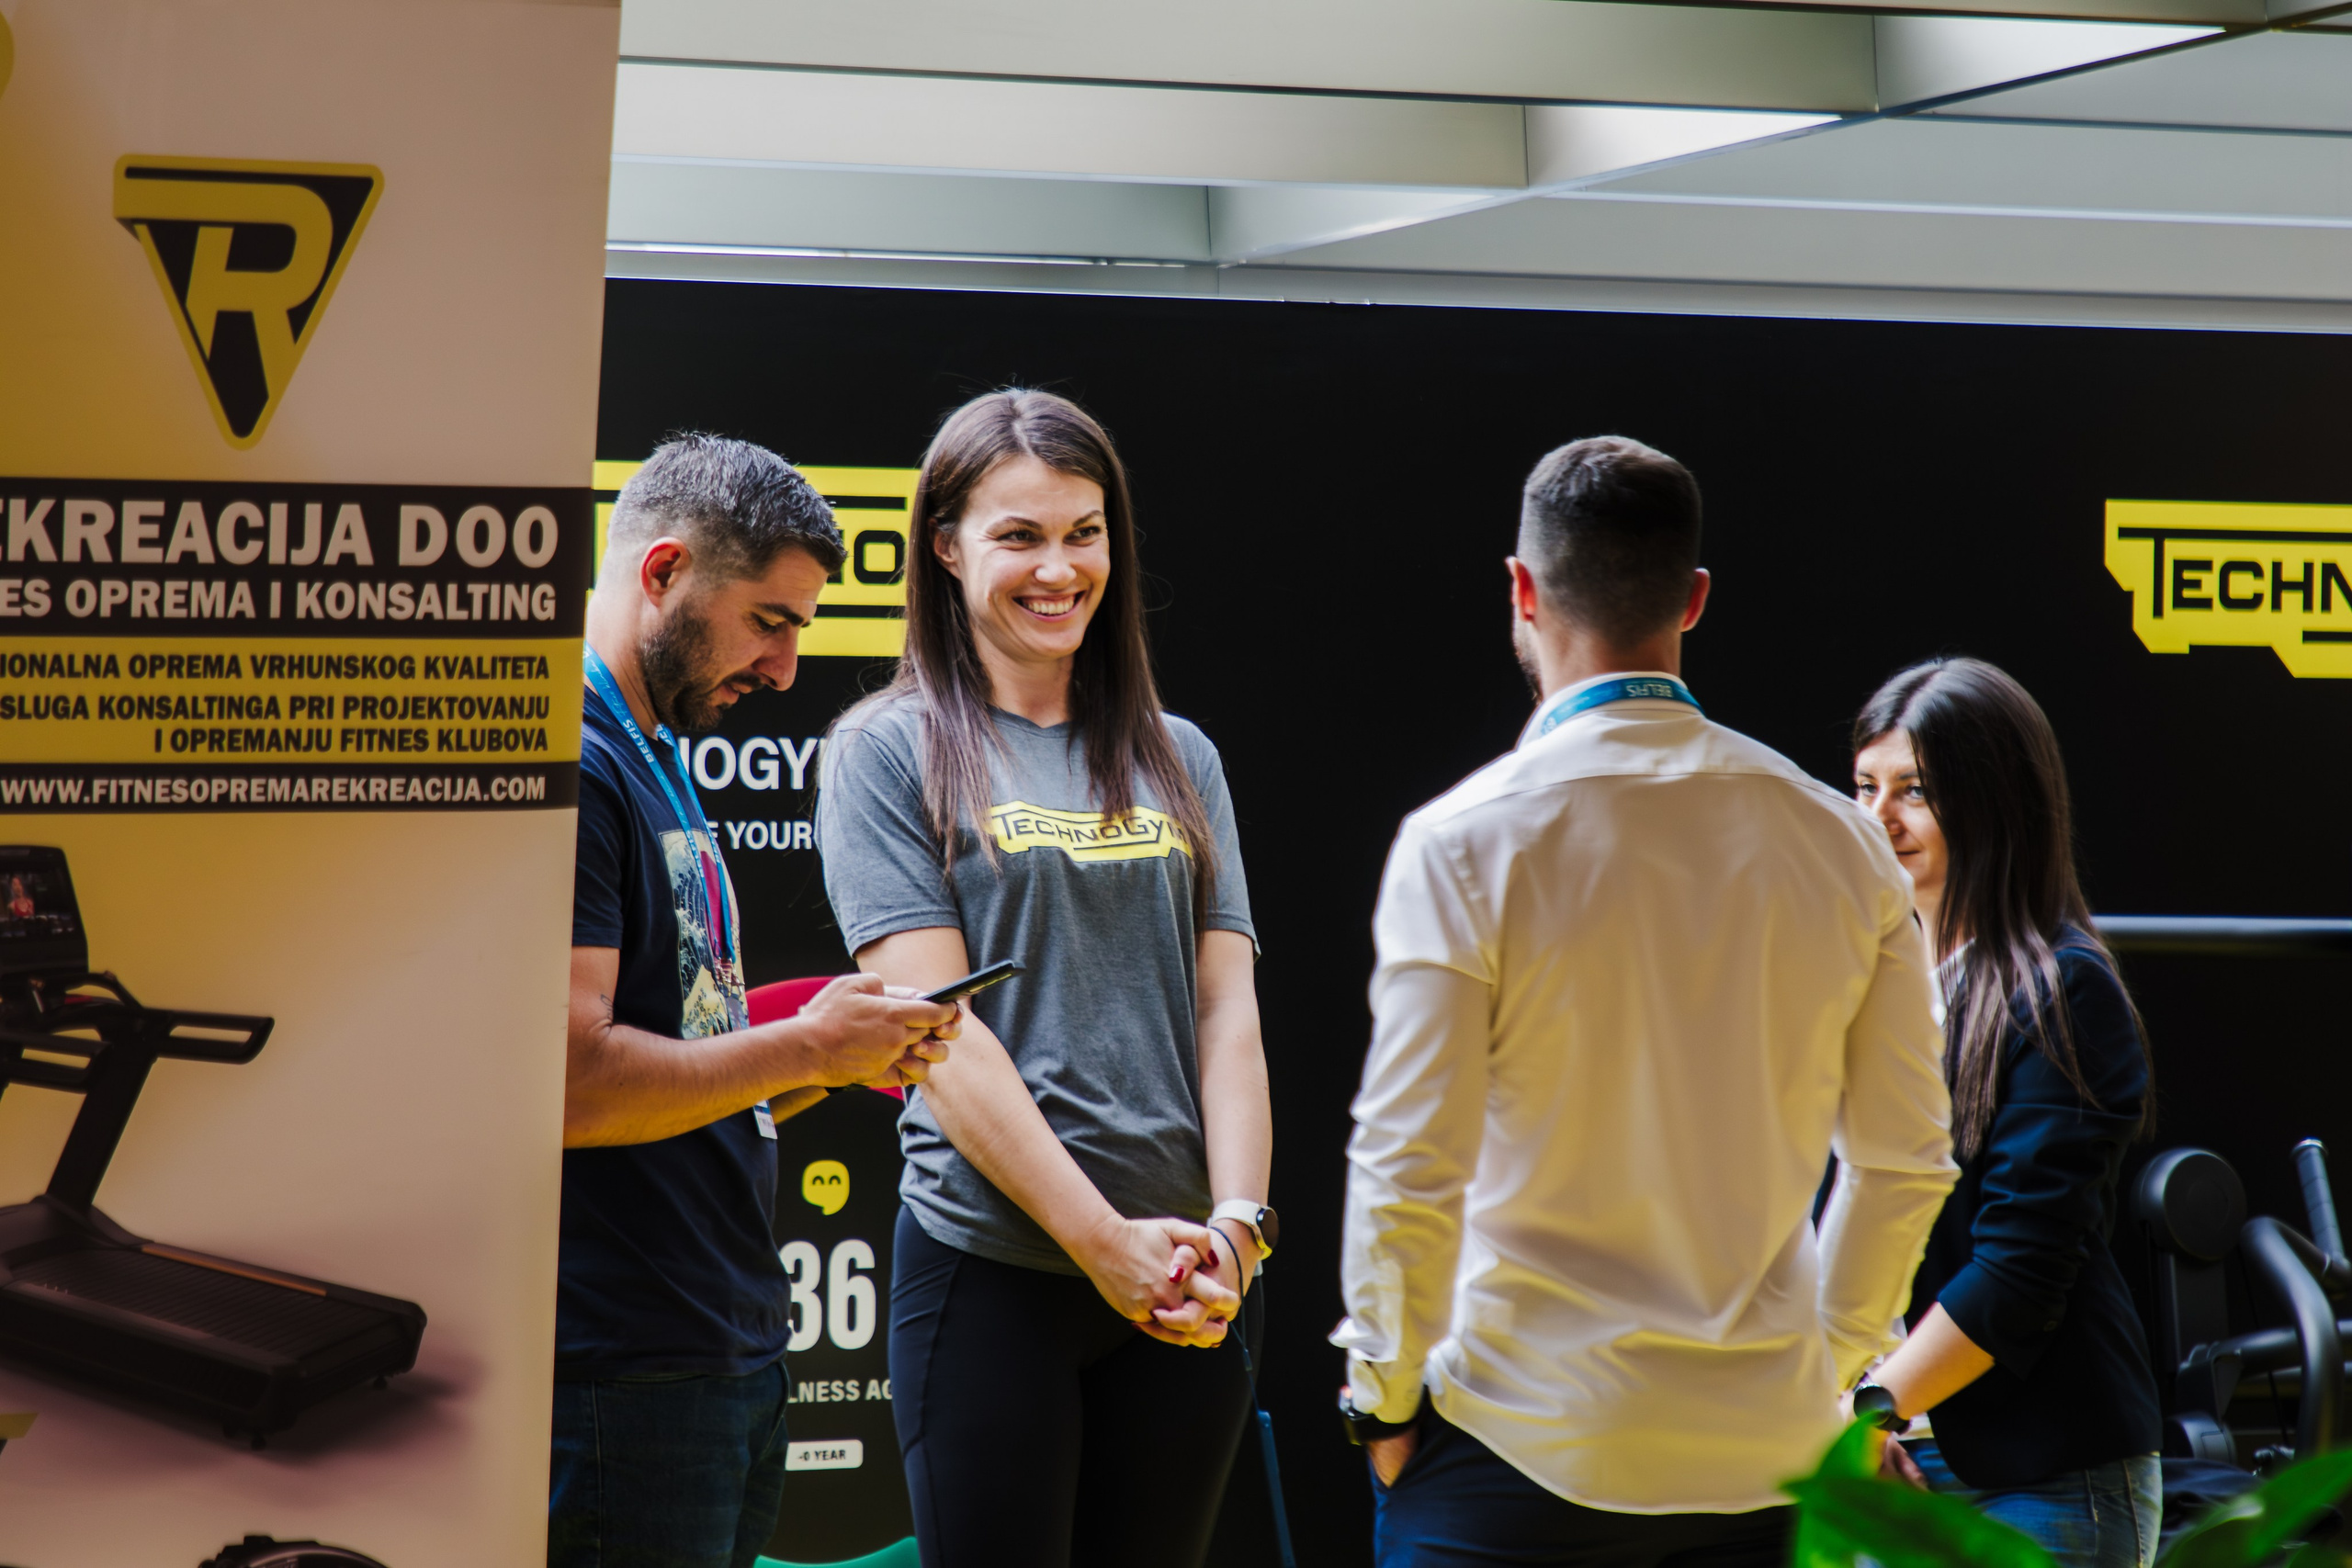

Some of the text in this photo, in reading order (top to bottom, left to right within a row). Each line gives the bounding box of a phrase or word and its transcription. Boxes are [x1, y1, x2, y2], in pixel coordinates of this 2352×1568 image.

[0, 498, 559, 569] KREACIJA DOO
[65, 580, 256, 618] OPREMA
[270, 581, 281, 618] I
[296, 581, 556, 620] KONSALTING
[129, 654, 243, 679] OPREMA
[251, 654, 415, 680] VRHUNSKOG
[424, 656, 549, 680] KVALITETA
[0, 695, 549, 720] SLUGA KONSALTINGA PRI PROJEKTOVANJU
[154, 728, 548, 752] I OPREMANJU FITNES KLUBOVA
[623, 719, 655, 763] BELFIS
[676, 736, 827, 790] OGY
[0, 776, 546, 804] WWW.FITNESOPREMAREKREACIJA.COM
[724, 821, 813, 850] YOUR
[779, 1239, 876, 1351] 36
[787, 1380, 860, 1403] NESS
[814, 1449, 846, 1461] YEAR
